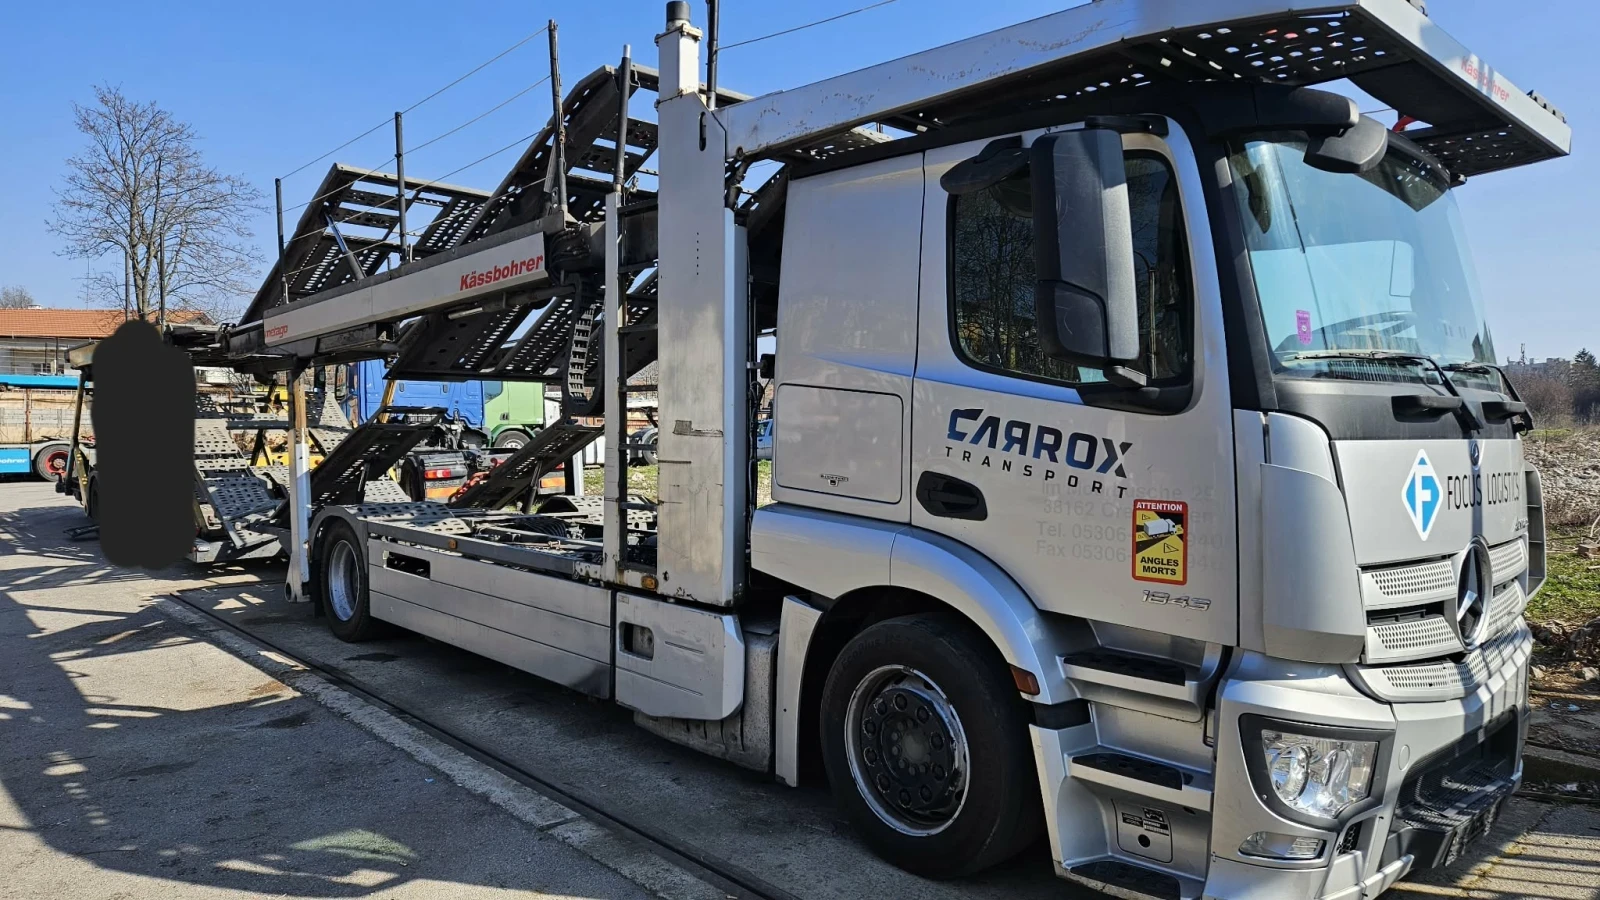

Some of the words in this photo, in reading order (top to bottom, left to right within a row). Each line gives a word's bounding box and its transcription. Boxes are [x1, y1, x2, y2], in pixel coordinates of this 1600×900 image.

[459, 255, 544, 291] Kässbohrer
[947, 408, 1133, 479] CARROX
[945, 446, 1127, 499] TRANSPORT
[1136, 502, 1183, 511] ATTENTION
[1447, 473, 1482, 510] FOCUS
[1486, 472, 1520, 505] LOGISTICS
[1140, 556, 1179, 567] ANGLES
[1142, 565, 1177, 576] MORTS
